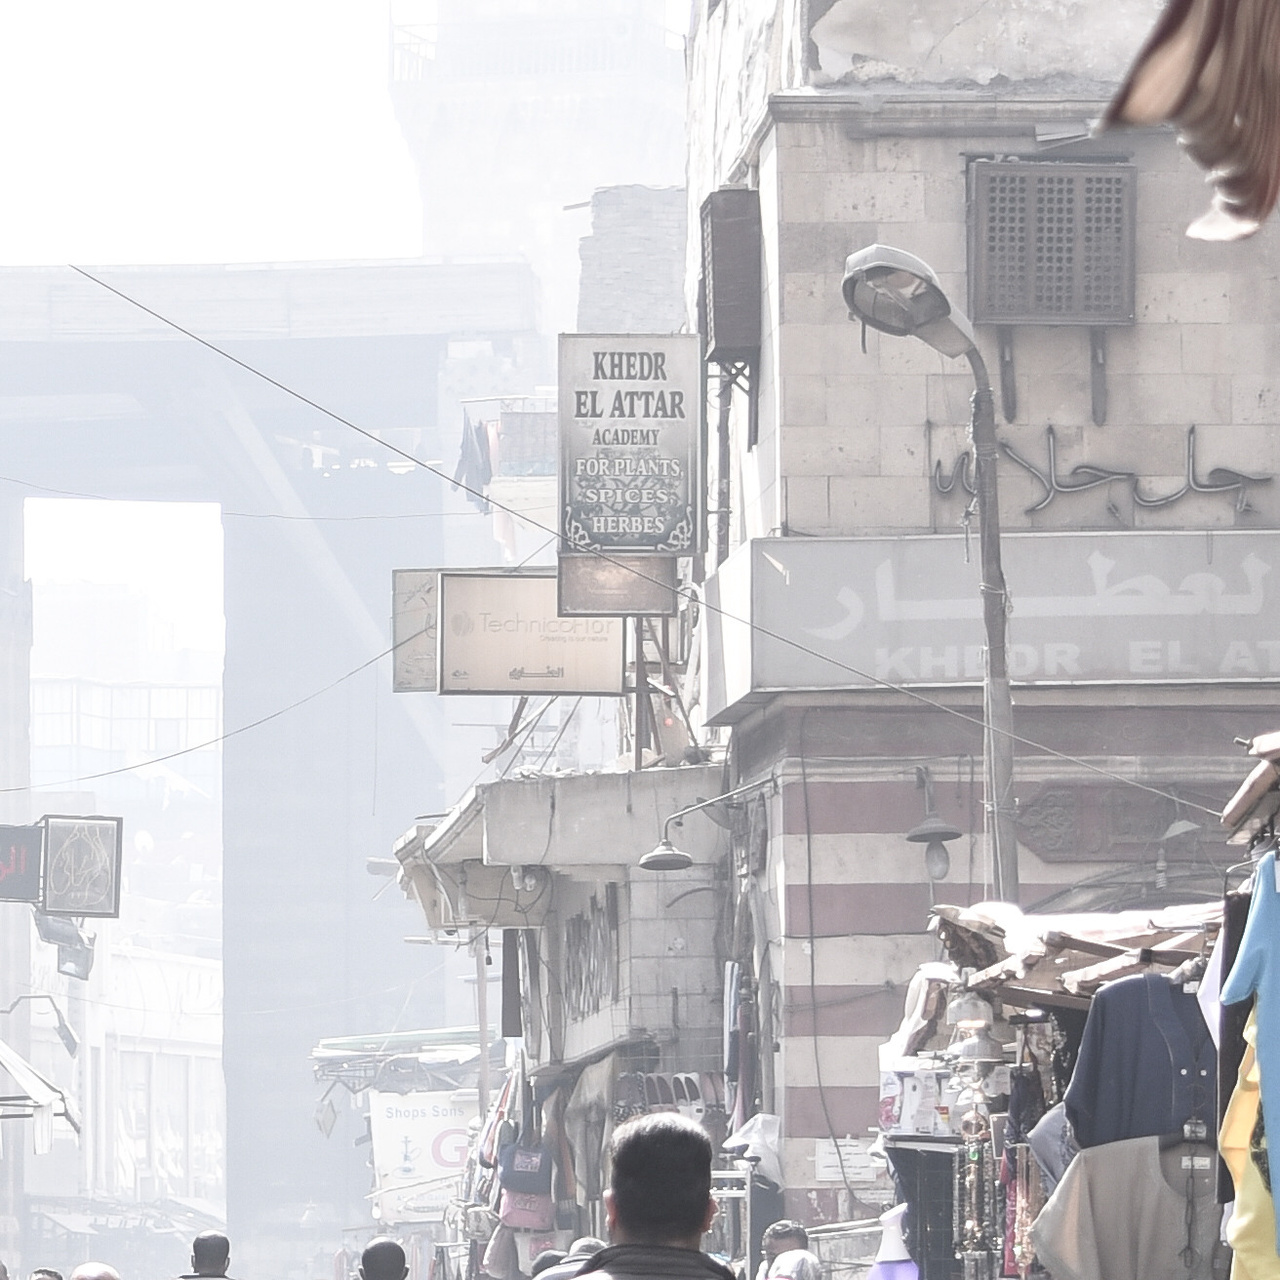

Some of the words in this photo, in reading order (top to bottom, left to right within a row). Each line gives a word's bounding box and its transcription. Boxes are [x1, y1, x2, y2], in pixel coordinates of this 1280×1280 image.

[593, 352, 667, 381] KHEDR
[575, 391, 604, 418] EL
[609, 390, 685, 418] ATTAR
[592, 428, 660, 446] ACADEMY
[576, 459, 609, 476] FOR
[614, 459, 684, 478] PLANTS,
[592, 516, 665, 534] HERBES
[1129, 641, 1199, 673] EL
[385, 1107, 427, 1120] Shops
[432, 1105, 464, 1117] Sons
